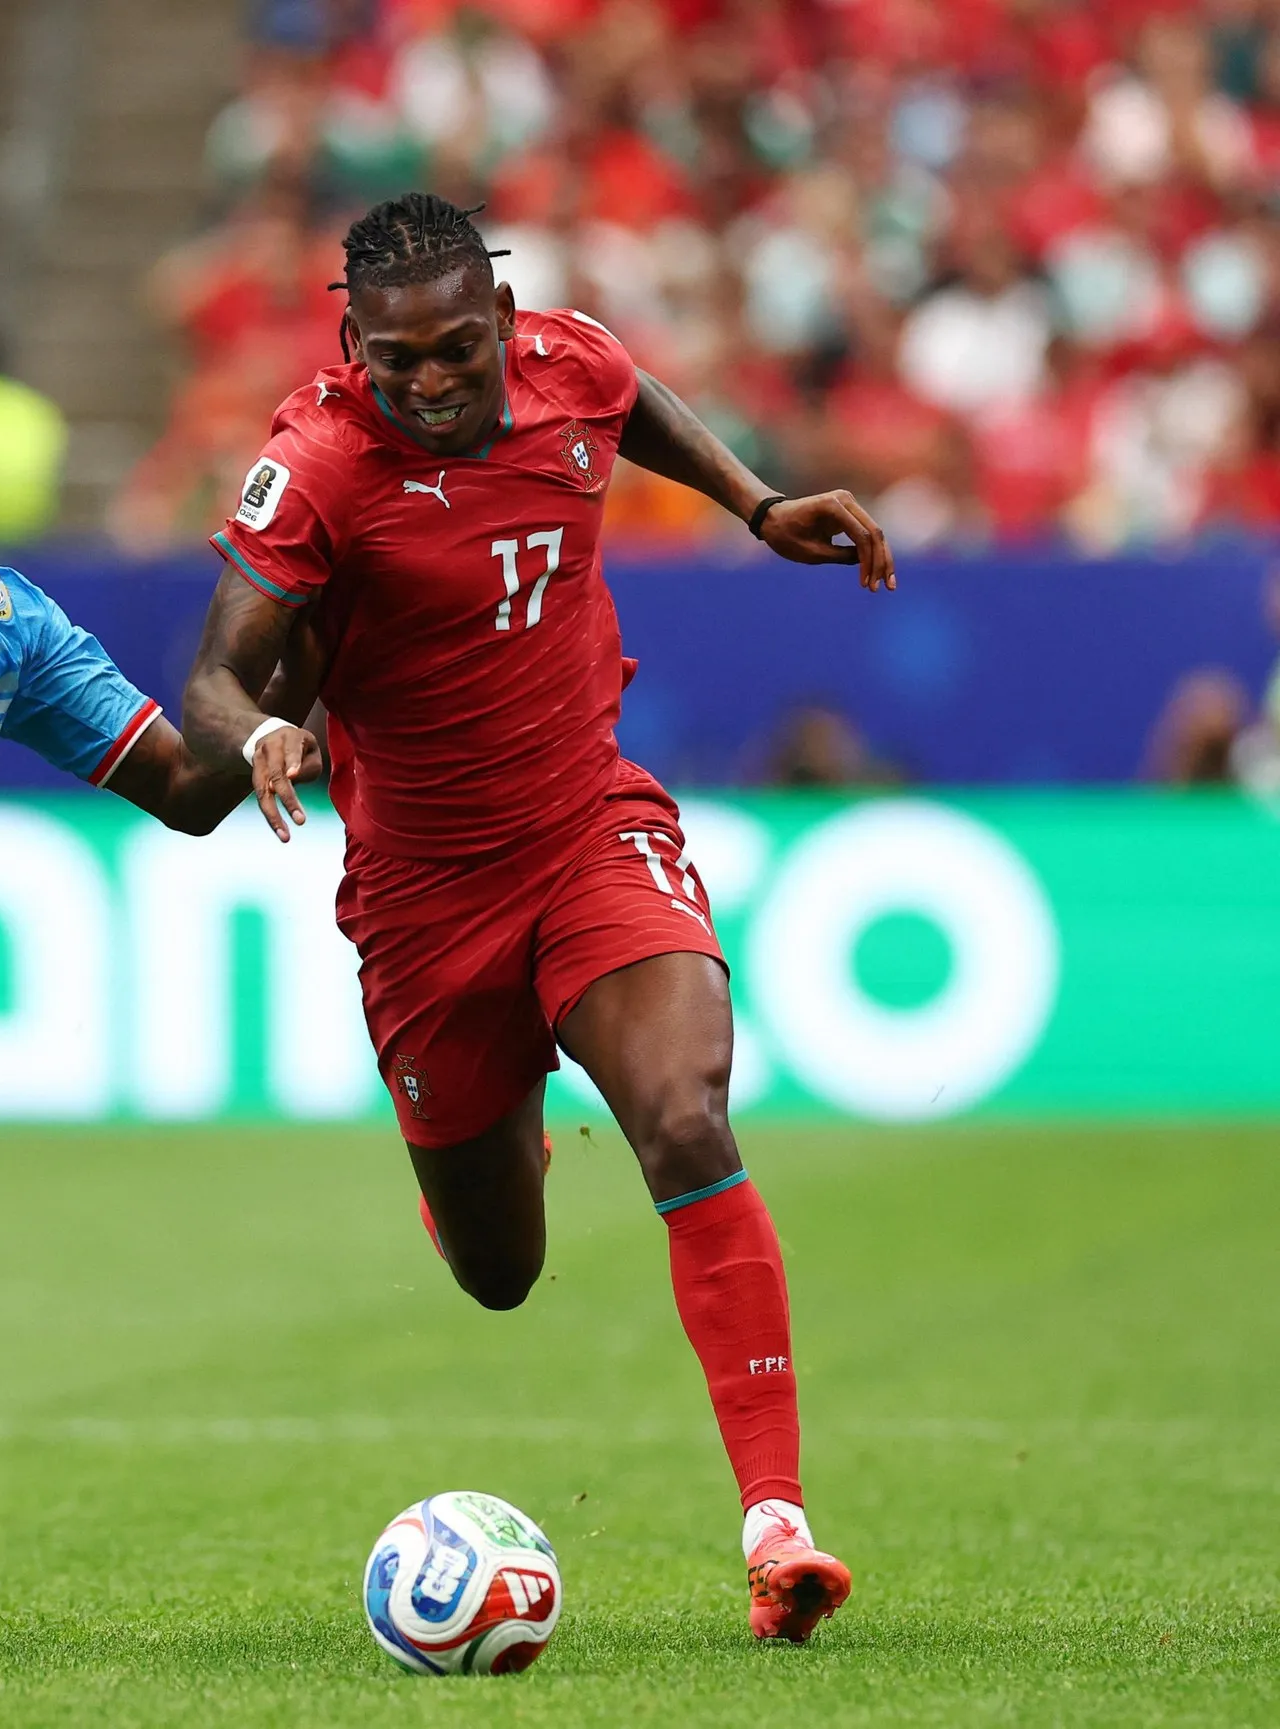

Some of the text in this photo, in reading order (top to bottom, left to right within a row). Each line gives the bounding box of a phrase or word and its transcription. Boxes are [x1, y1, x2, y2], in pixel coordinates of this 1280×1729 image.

[246, 494, 260, 505] FIFA
[491, 526, 564, 631] 17
[619, 832, 697, 904] 17
